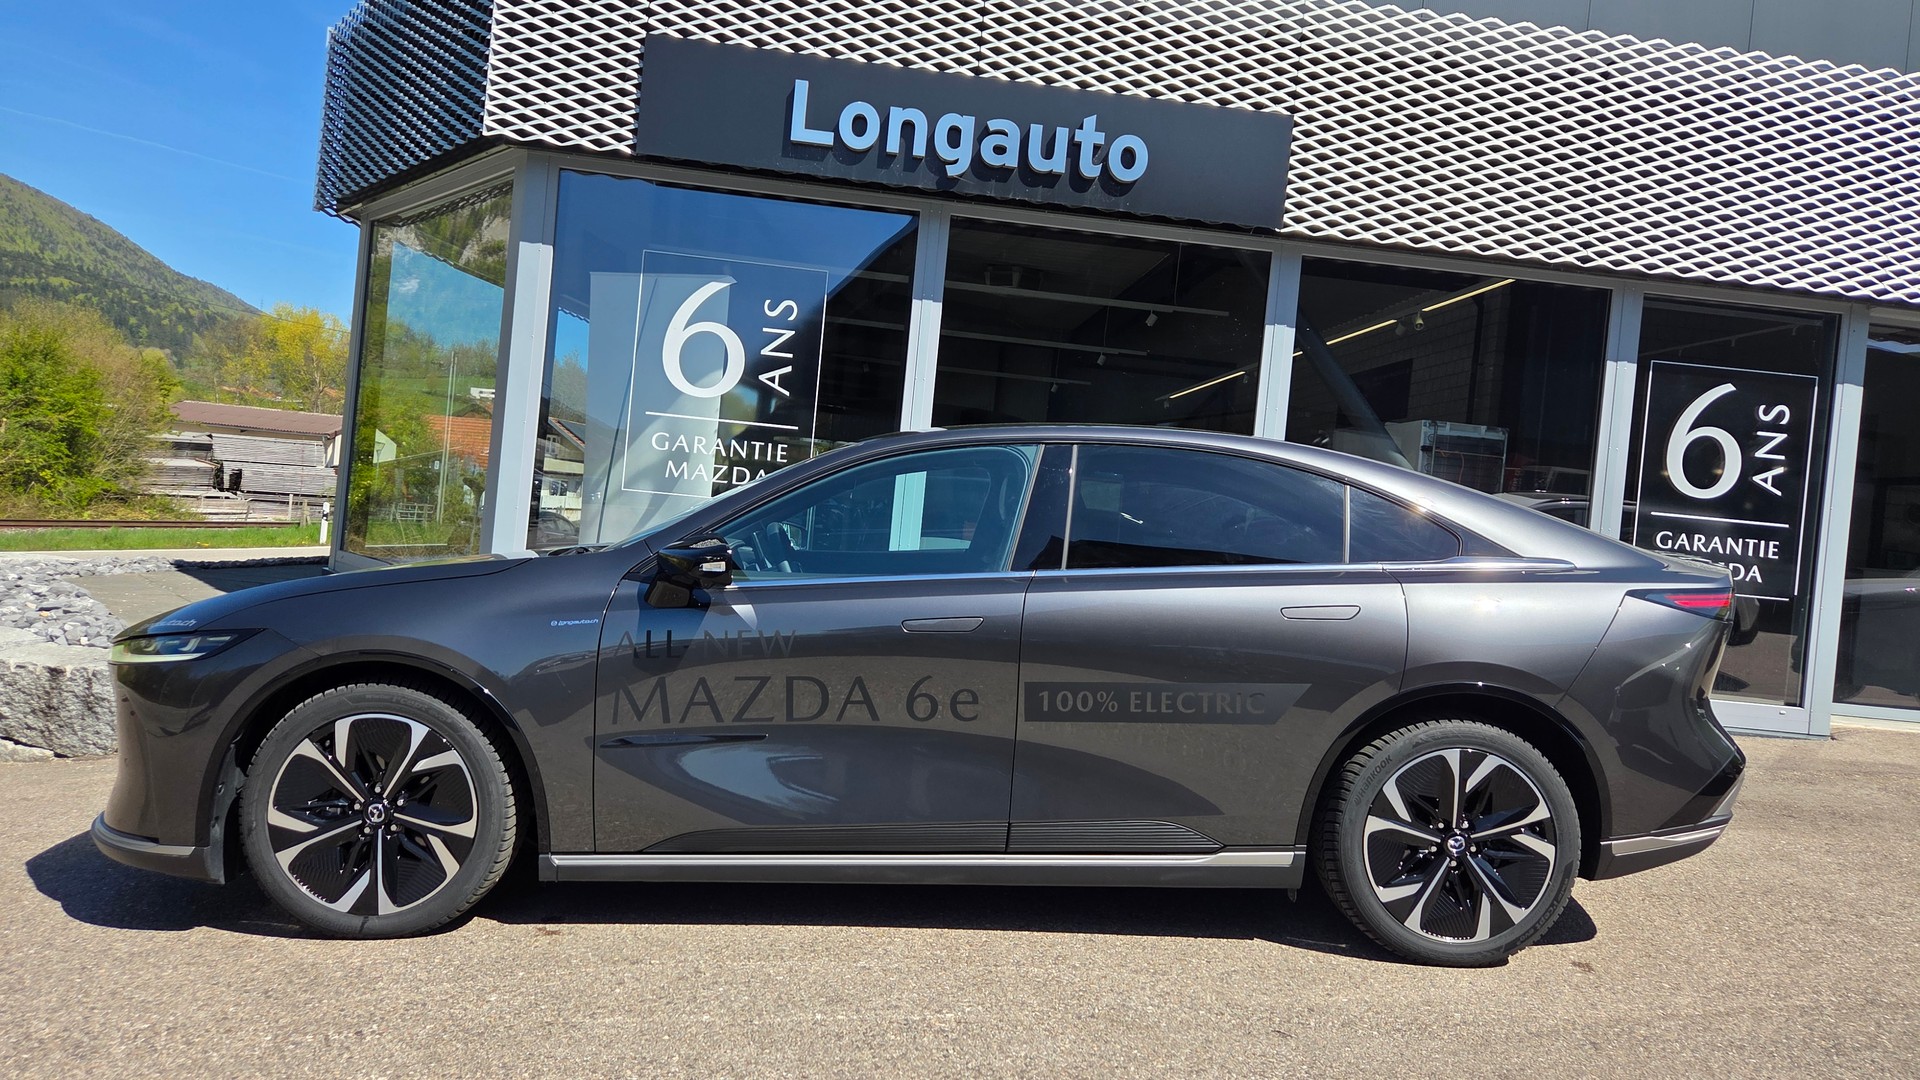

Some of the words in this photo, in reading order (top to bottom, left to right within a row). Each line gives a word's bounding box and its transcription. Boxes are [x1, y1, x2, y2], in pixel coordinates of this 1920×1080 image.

[790, 79, 1149, 184] Longauto
[662, 281, 745, 398] 6
[758, 299, 798, 396] ANS
[651, 432, 789, 463] GARANTIE
[1666, 382, 1742, 500] 6
[1752, 404, 1790, 496] ANS
[1655, 530, 1780, 559] GARANTIE
[611, 675, 881, 725] MAZDA
[905, 675, 980, 722] 6e
[1038, 690, 1119, 713] 100%
[1129, 691, 1266, 714] ELECTRIC
